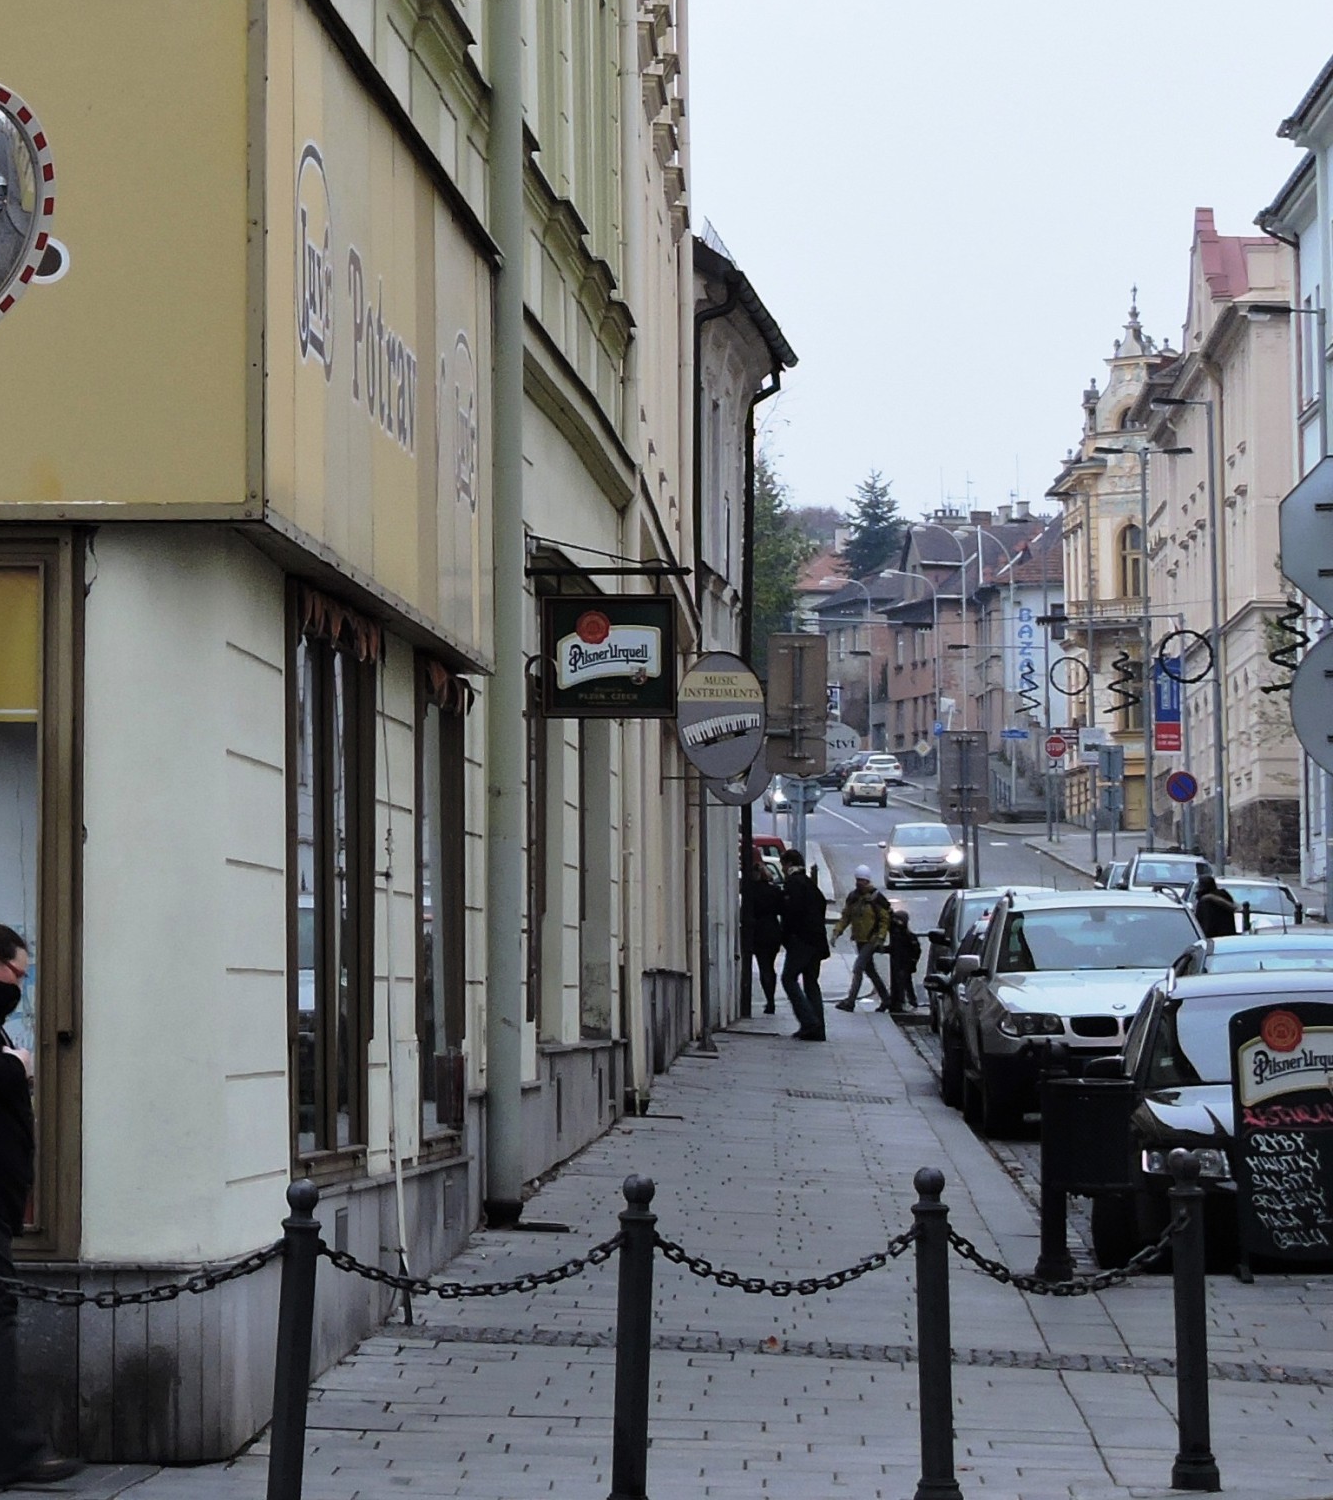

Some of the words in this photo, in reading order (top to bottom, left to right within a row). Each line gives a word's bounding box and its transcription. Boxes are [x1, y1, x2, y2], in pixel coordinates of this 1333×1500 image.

[349, 244, 417, 458] Potrav
[569, 644, 610, 673] Pilsner
[609, 643, 648, 664] Urquell
[704, 675, 738, 685] MUSIC
[684, 688, 760, 699] INSTRUMENTS
[1046, 743, 1064, 752] STOP
[1252, 1050, 1303, 1084] Pilsner
[1251, 1131, 1305, 1153] RYBY
